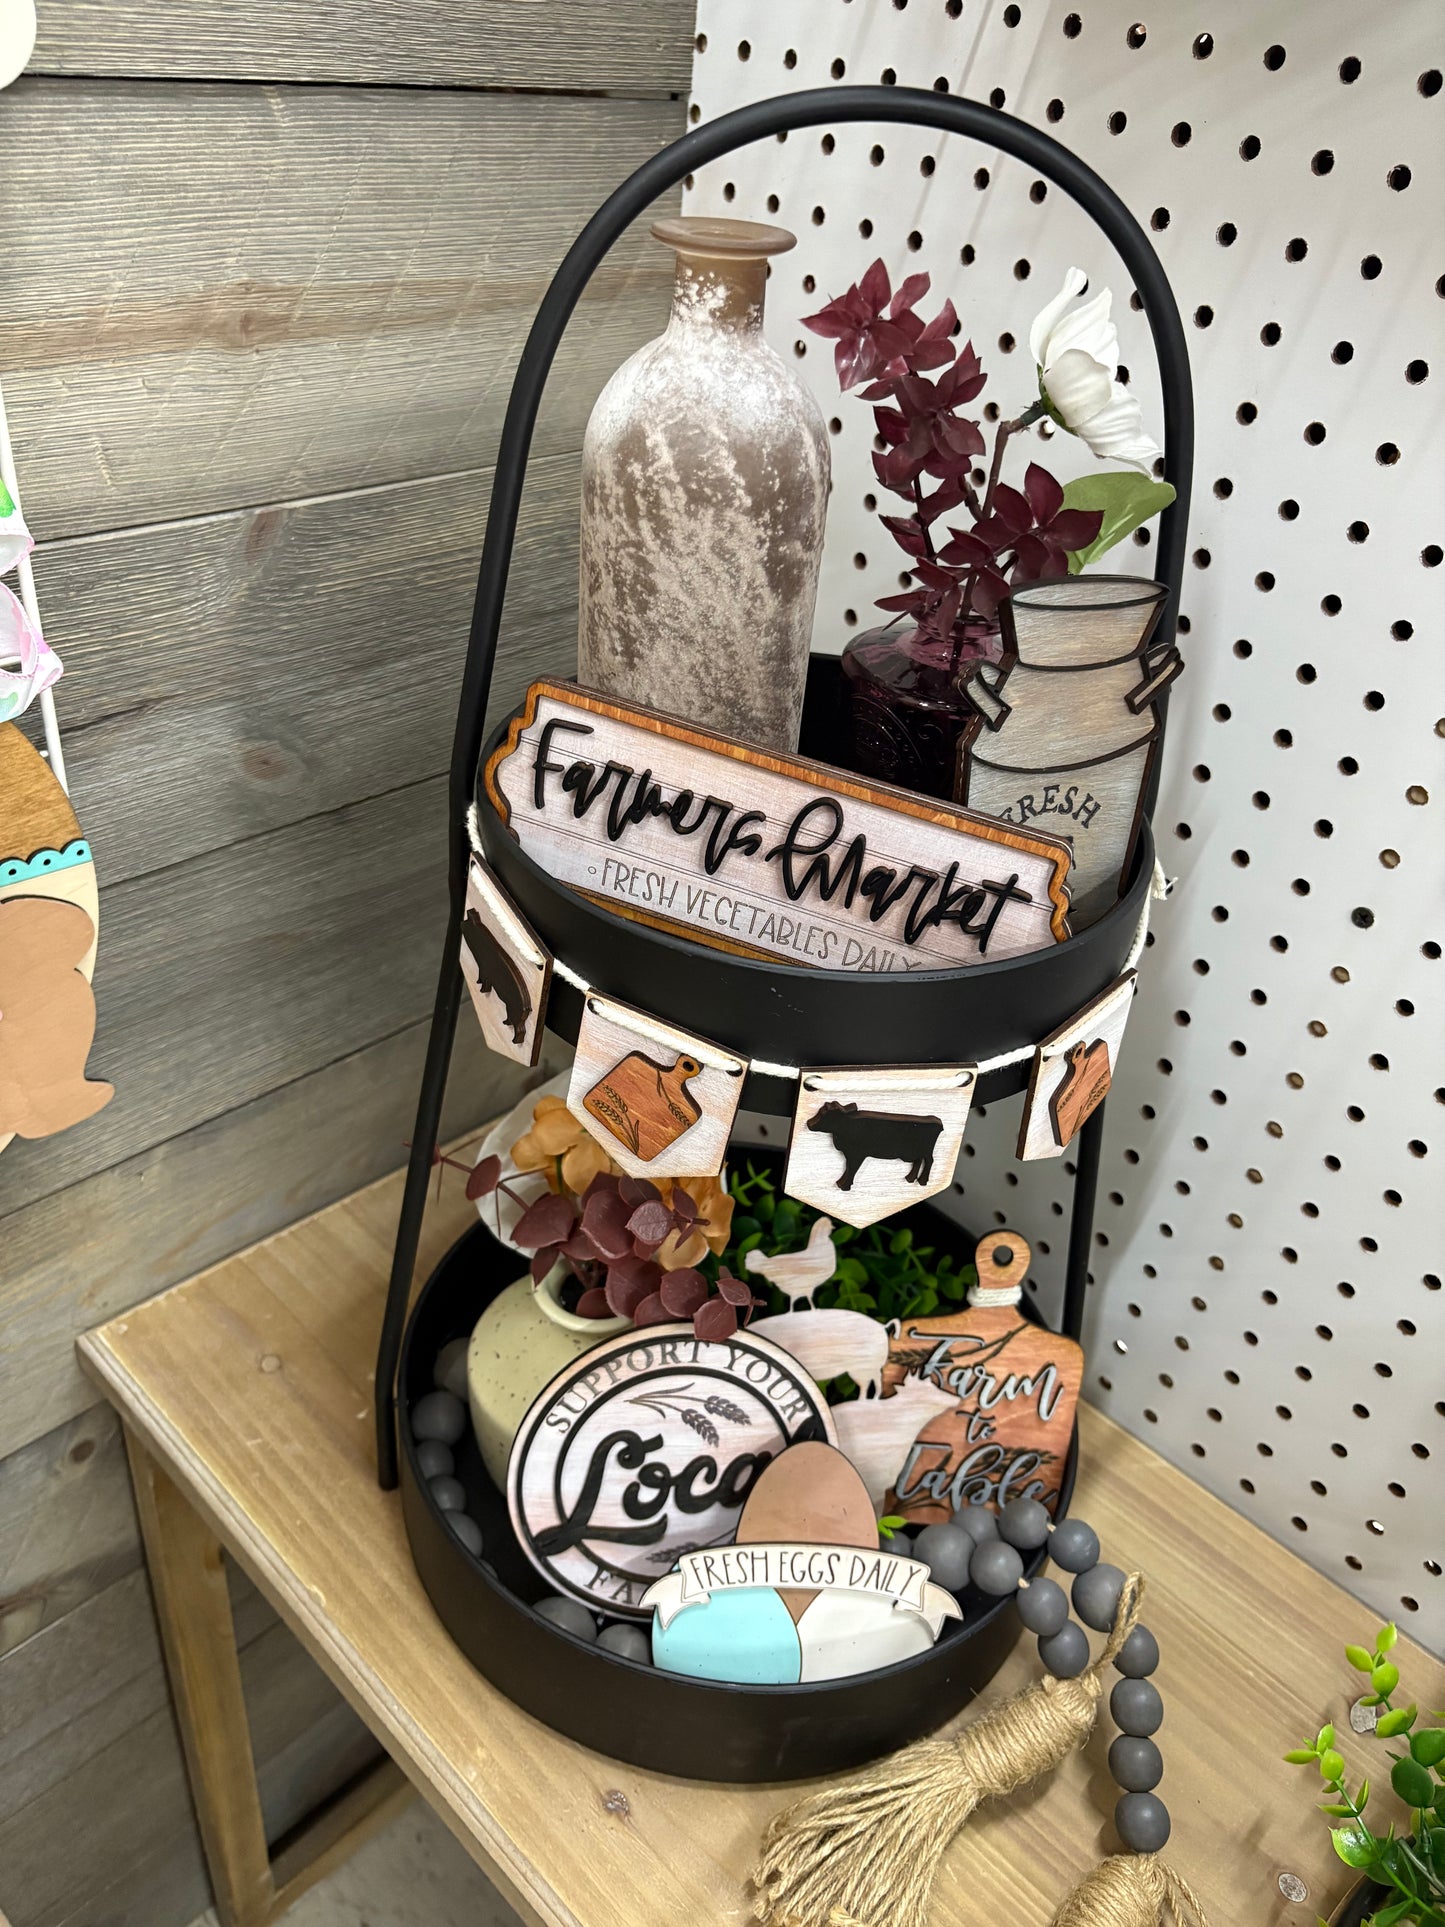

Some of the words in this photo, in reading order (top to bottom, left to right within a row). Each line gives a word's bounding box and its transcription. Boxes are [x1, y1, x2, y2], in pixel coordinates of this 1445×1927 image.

[532, 718, 767, 876] Farmers
[764, 796, 1033, 954] Market
[601, 858, 679, 909] FRESH
[687, 884, 838, 960] VEGETABLES
[545, 1339, 711, 1435] SUPPORT
[723, 1344, 811, 1423] YOUR
[907, 1325, 1064, 1422] Farm
[955, 1407, 997, 1444] to
[533, 1417, 828, 1557] Loca
[689, 1550, 769, 1590] FRESH
[779, 1551, 841, 1585] EGGS
[848, 1554, 923, 1597] DAILY
